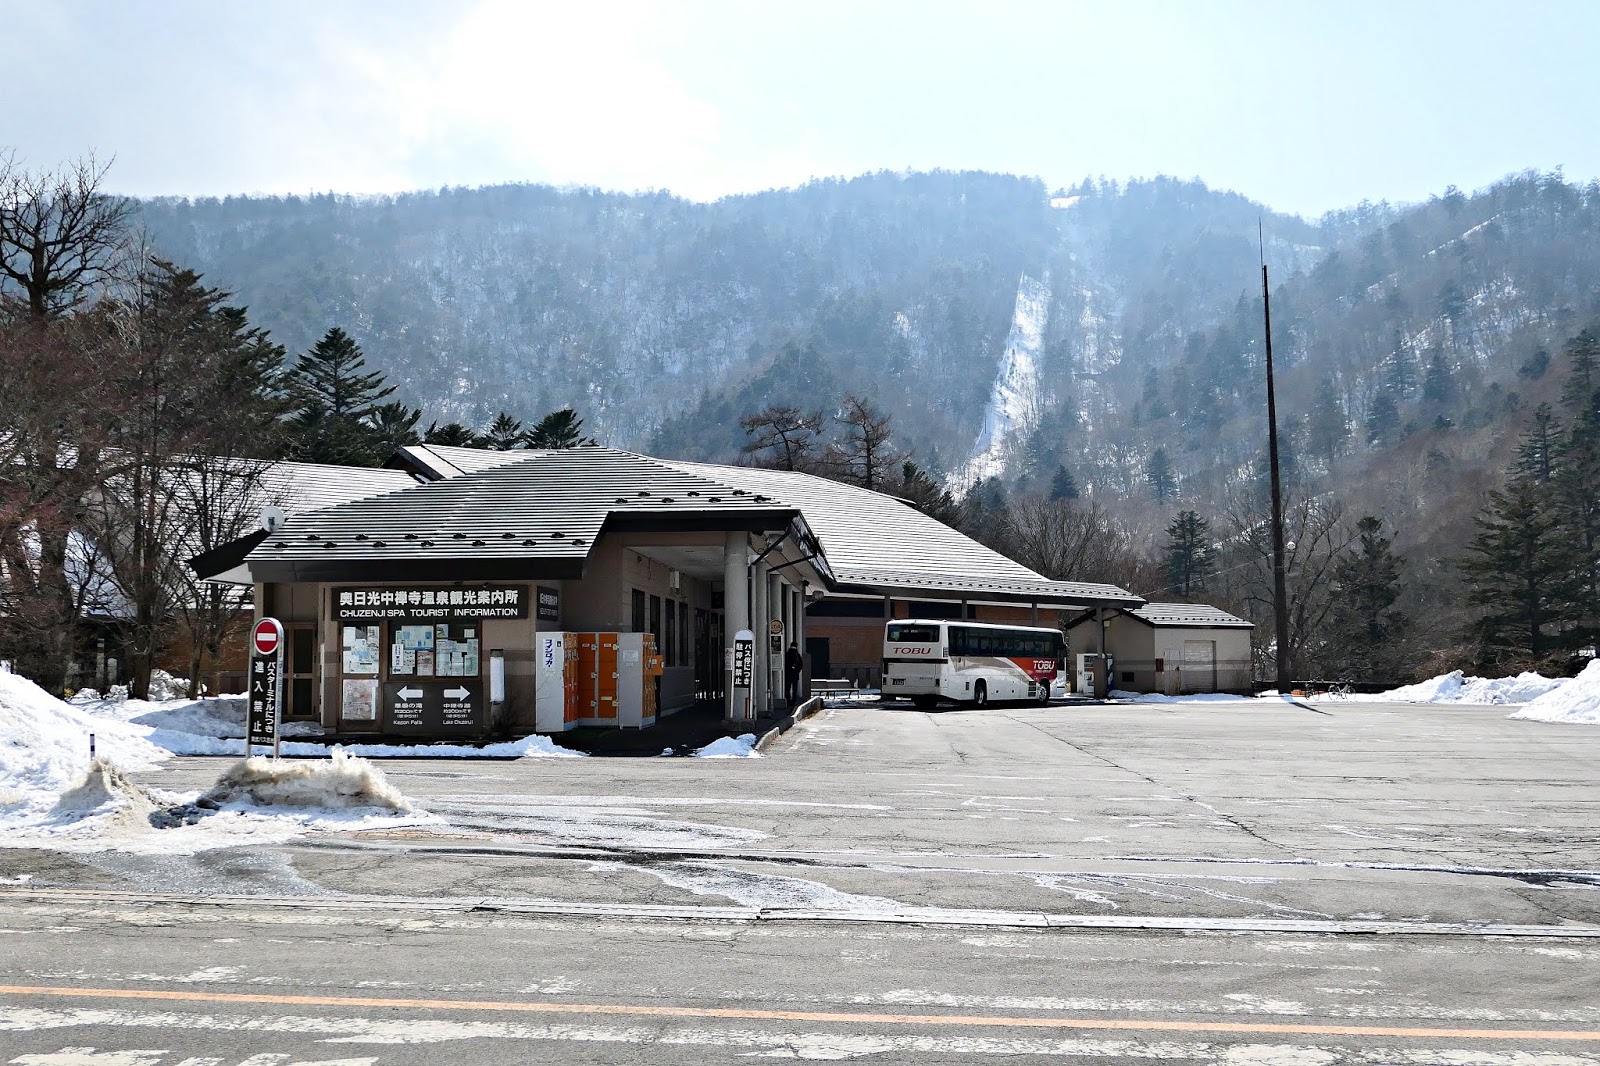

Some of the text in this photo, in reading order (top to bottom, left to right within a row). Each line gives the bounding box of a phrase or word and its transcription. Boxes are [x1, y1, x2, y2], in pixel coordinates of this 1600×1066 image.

[340, 590, 518, 605] 奥日光中禅寺温泉観光案内所
[340, 608, 518, 618] CHUZENJI SPA TOURIST INFORMATION
[545, 639, 553, 668] コインロッカ
[735, 643, 743, 685] 駐停車禁止
[743, 643, 752, 685] バス停につき
[892, 647, 932, 655] TOBU
[1032, 660, 1055, 670] TOBU
[252, 661, 265, 733] 進入禁止
[265, 661, 276, 733] バスターミナルにつき
